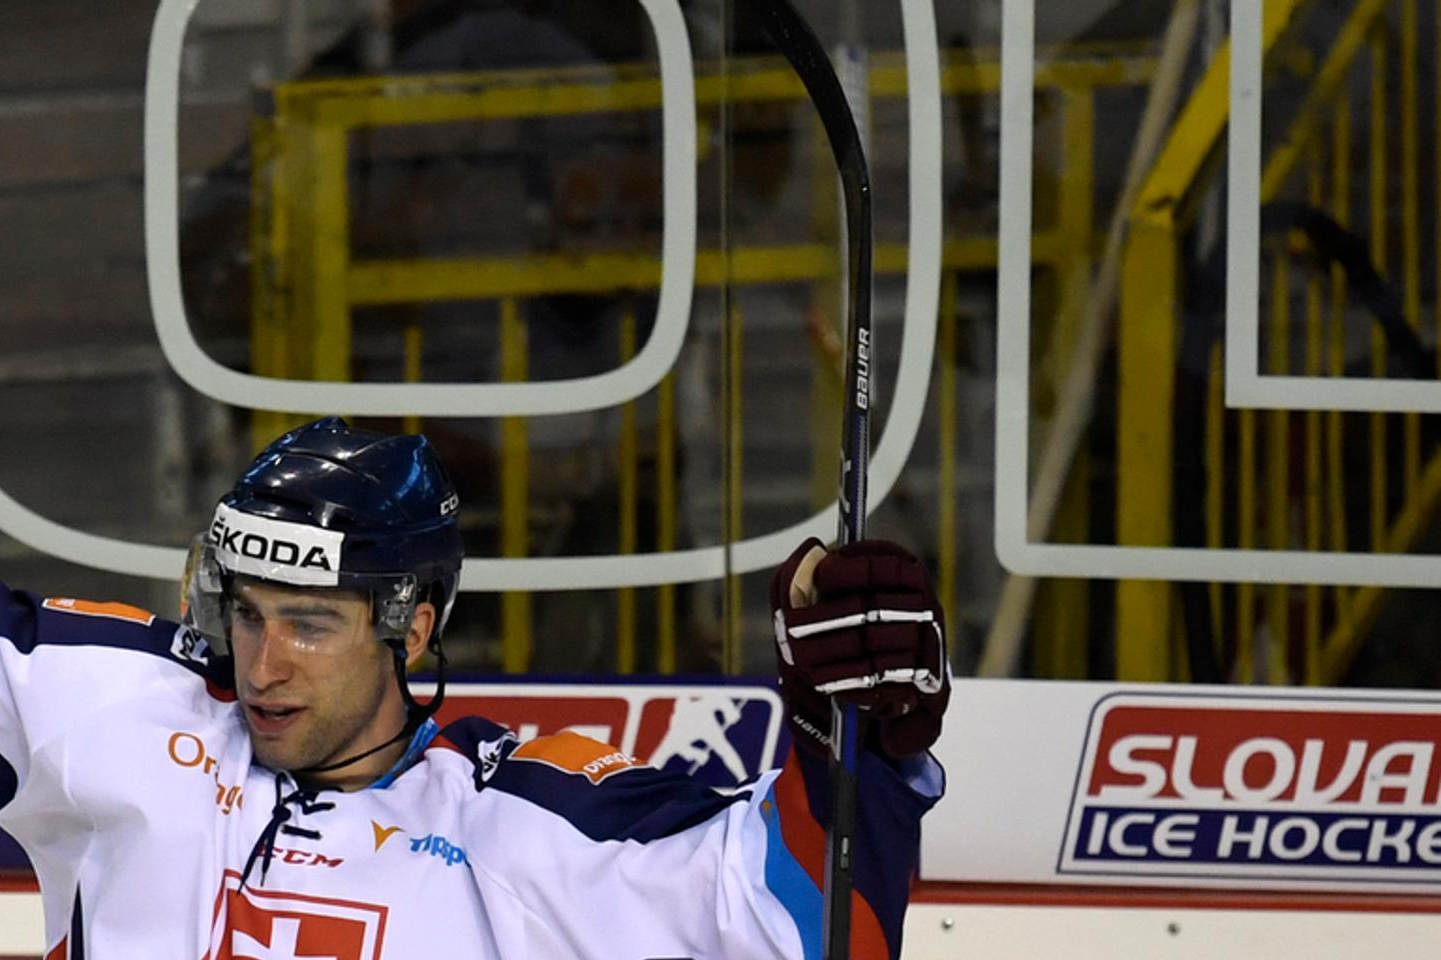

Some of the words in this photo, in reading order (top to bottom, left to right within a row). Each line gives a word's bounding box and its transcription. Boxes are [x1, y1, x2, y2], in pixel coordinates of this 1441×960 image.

[210, 517, 332, 571] ŠKODA
[1099, 734, 1441, 805] SLOVA
[1085, 810, 1200, 858] ICE
